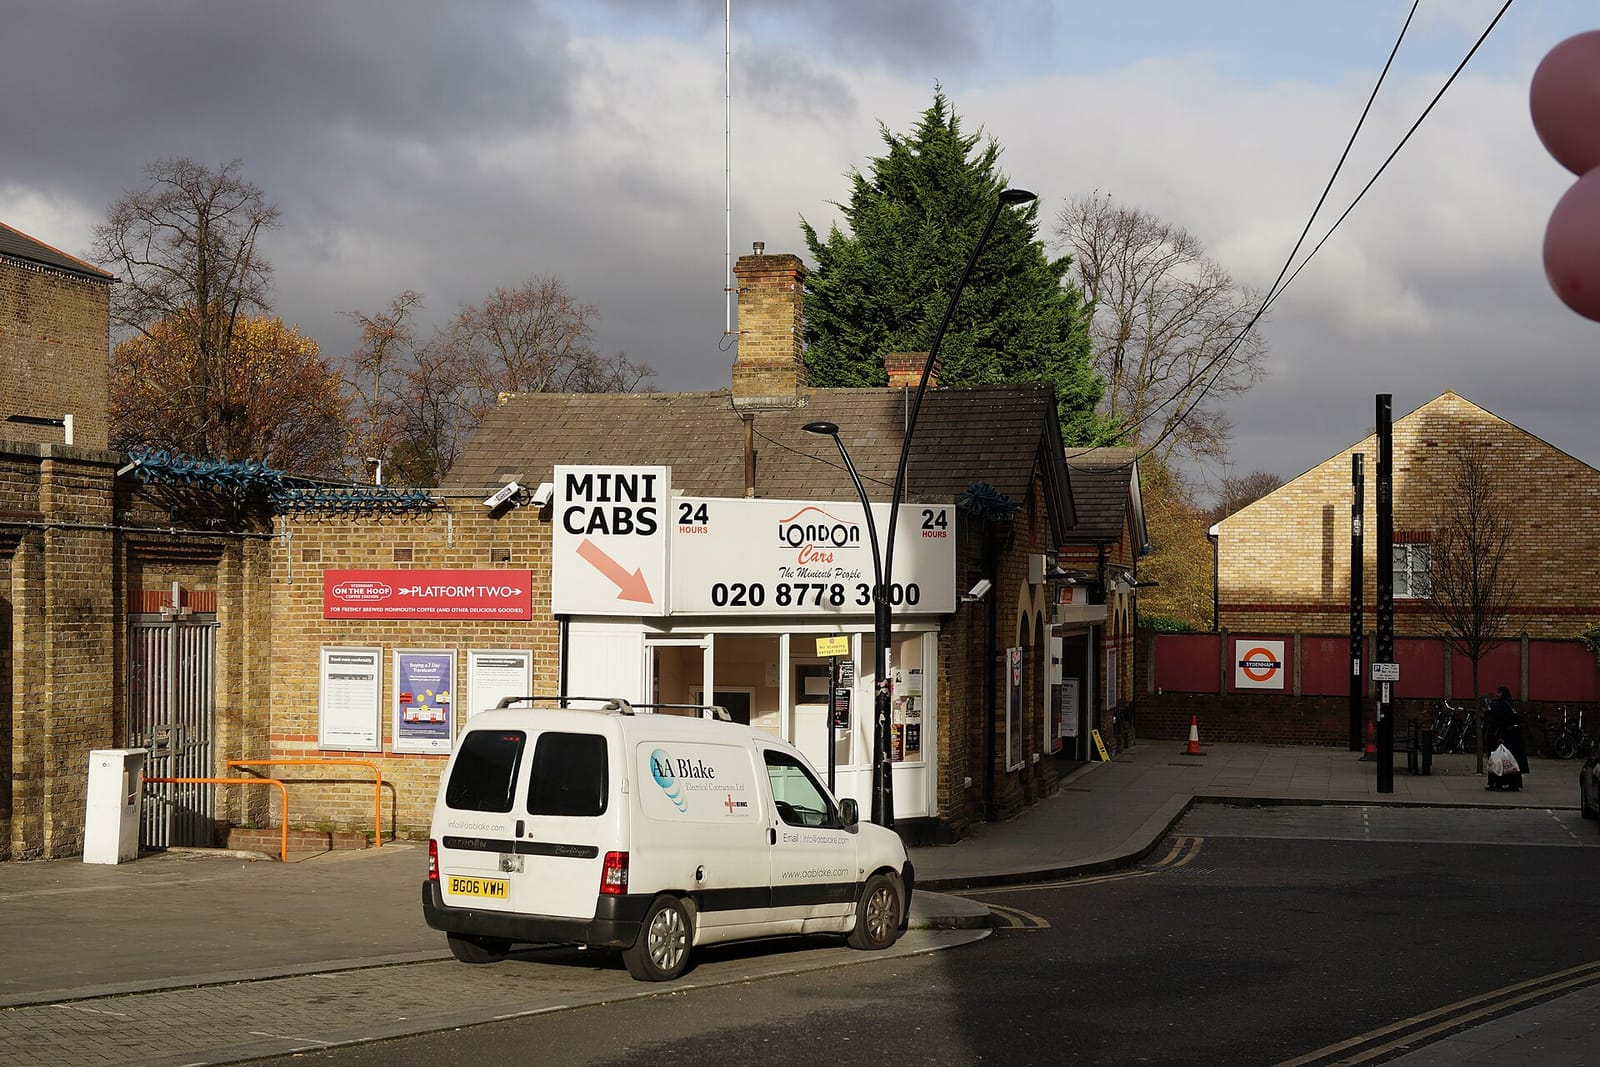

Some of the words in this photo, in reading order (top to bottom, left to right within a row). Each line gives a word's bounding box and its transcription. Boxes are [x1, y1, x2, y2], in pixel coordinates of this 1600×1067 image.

[566, 474, 657, 503] MINI
[563, 505, 657, 536] CABS
[678, 502, 709, 525] 24
[921, 509, 948, 530] 24
[678, 525, 708, 535] HOURS
[778, 523, 860, 547] LONDON
[921, 530, 947, 539] HOURS
[797, 544, 834, 565] Cars
[778, 566, 794, 579] The
[796, 567, 832, 579] Minicab
[834, 567, 862, 581] People
[411, 586, 475, 597] PLATFORM
[477, 586, 512, 597] TWO
[711, 583, 765, 607] 020
[775, 583, 846, 607] 8778
[652, 758, 676, 778] AA
[676, 758, 716, 779] Blake
[685, 783, 709, 791] Electrical
[783, 833, 799, 843] Email
[781, 867, 849, 879] www.aablake.com
[452, 878, 480, 895] BG06
[482, 880, 505, 896] VWH
